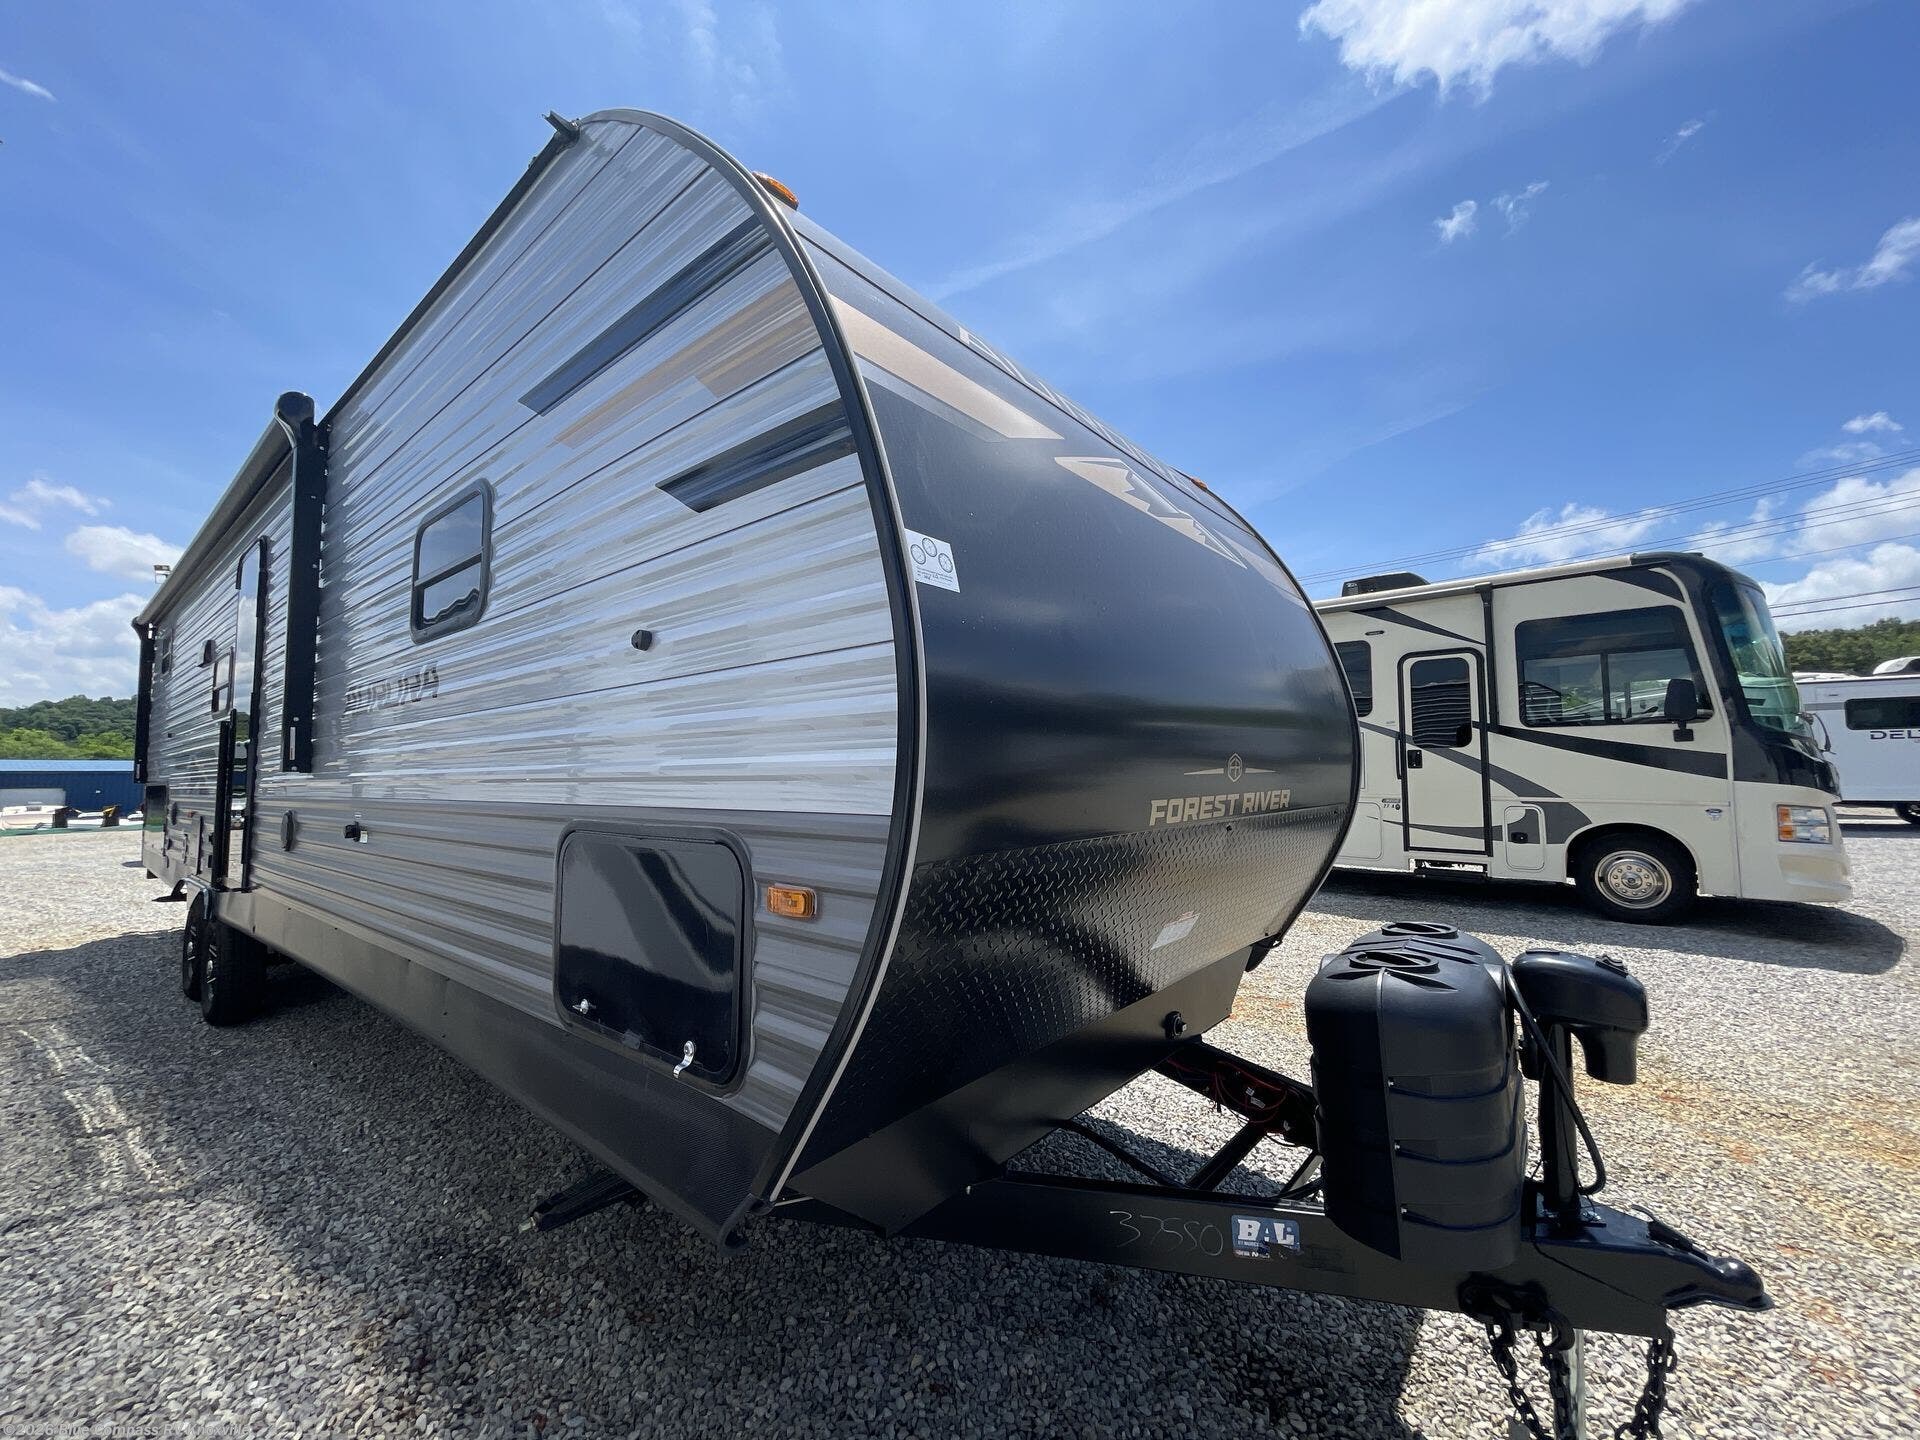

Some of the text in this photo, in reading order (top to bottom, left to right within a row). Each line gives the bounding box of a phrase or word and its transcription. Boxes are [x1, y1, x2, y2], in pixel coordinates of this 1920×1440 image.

[1869, 729, 1920, 740] DEL
[1149, 789, 1291, 826] FOREST RIVER
